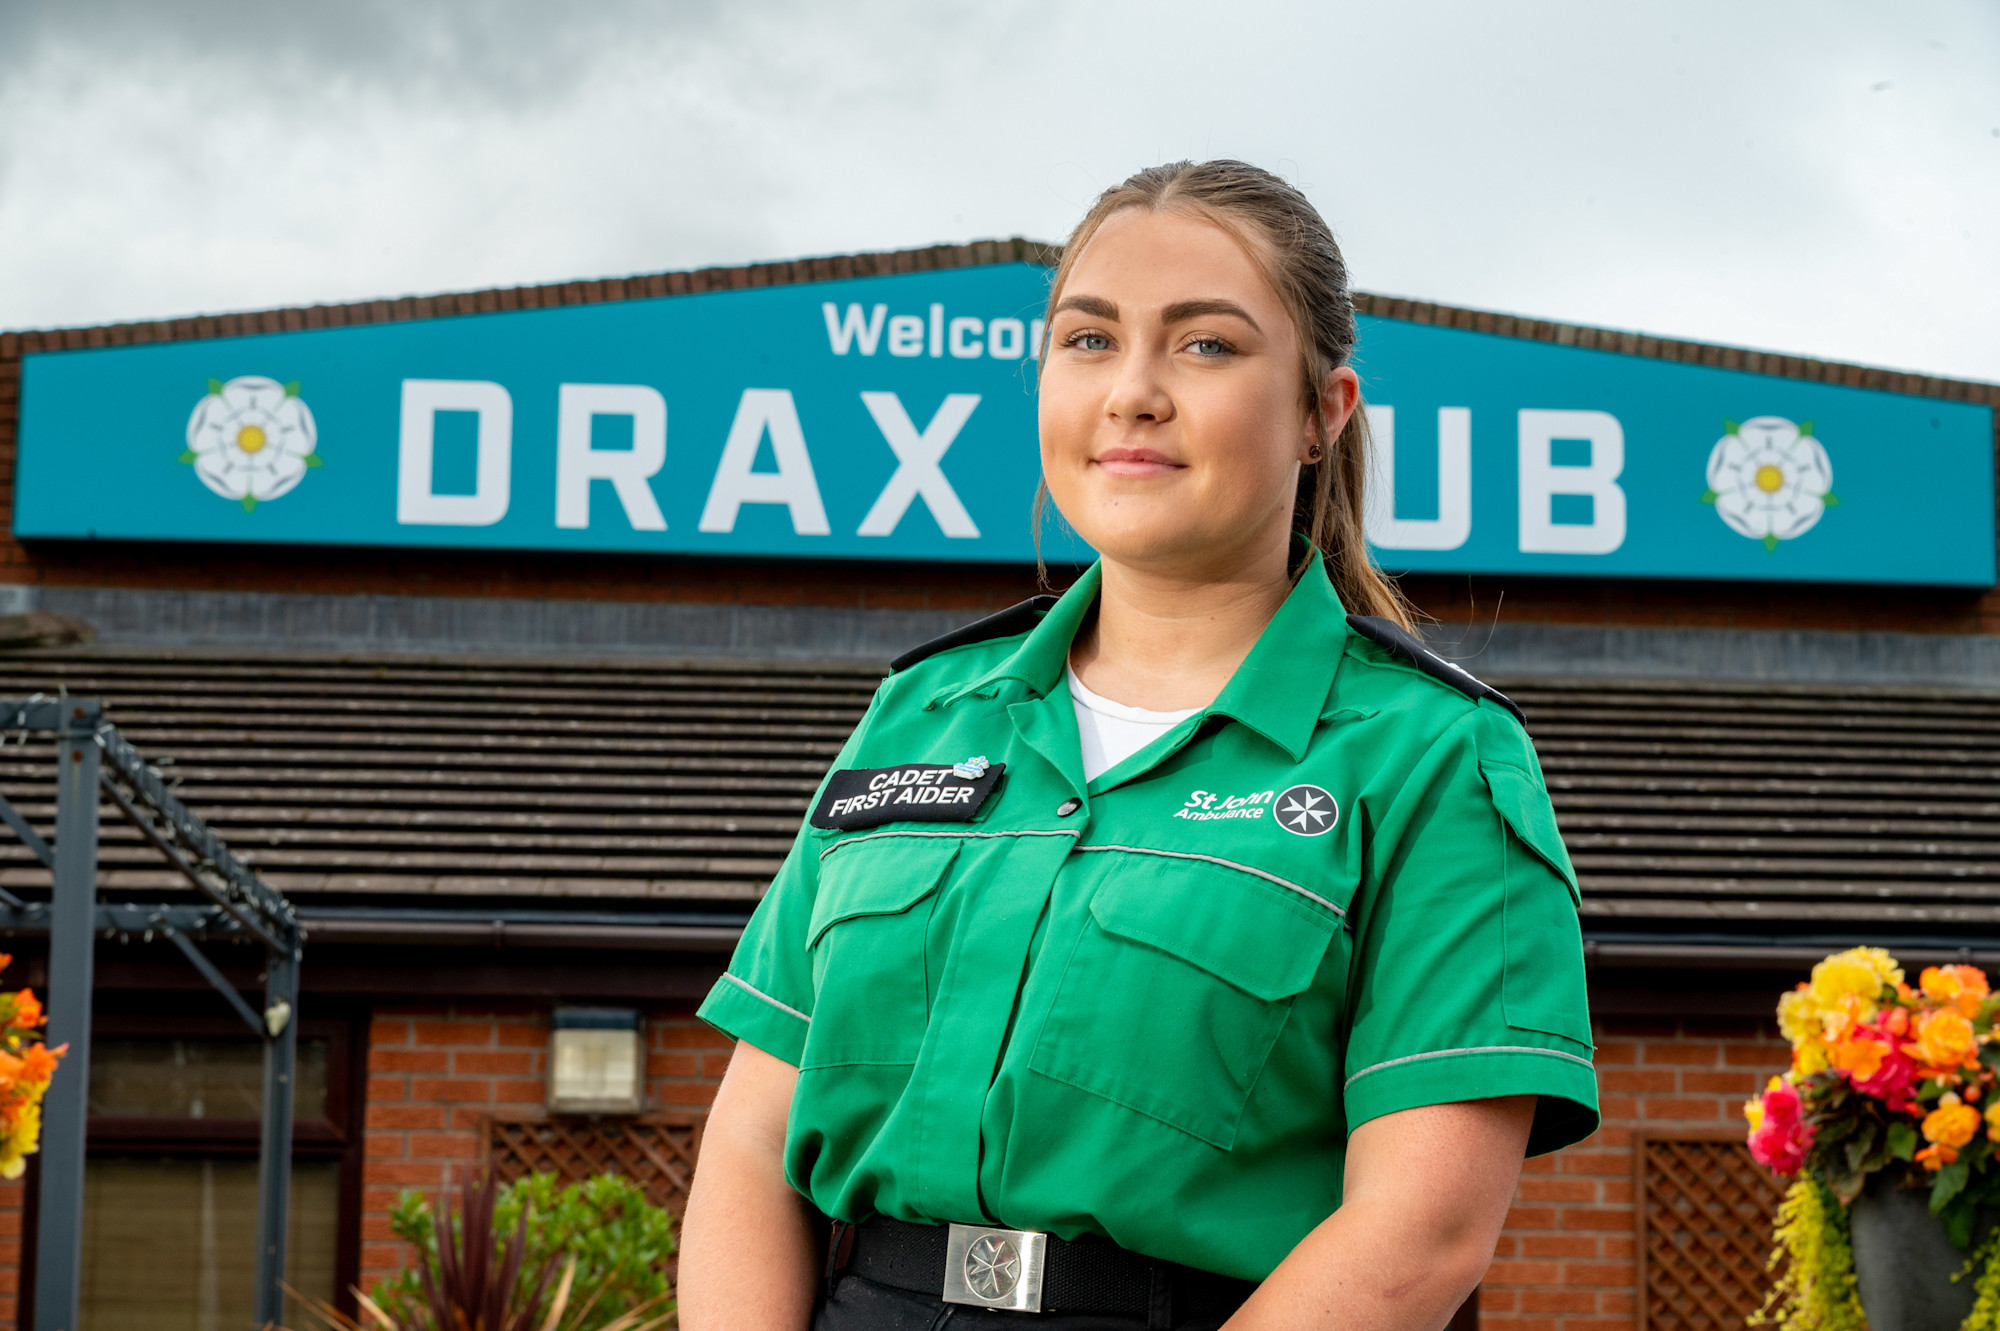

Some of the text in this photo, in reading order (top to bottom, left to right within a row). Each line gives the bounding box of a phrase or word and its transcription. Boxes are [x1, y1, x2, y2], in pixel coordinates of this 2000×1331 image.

[822, 302, 1048, 360] Welco
[396, 378, 1627, 555] DRAX UB
[868, 769, 953, 791] CADET
[828, 786, 975, 818] FIRST AIDER
[1184, 790, 1275, 810] St John
[1173, 808, 1264, 821] Ambulance
